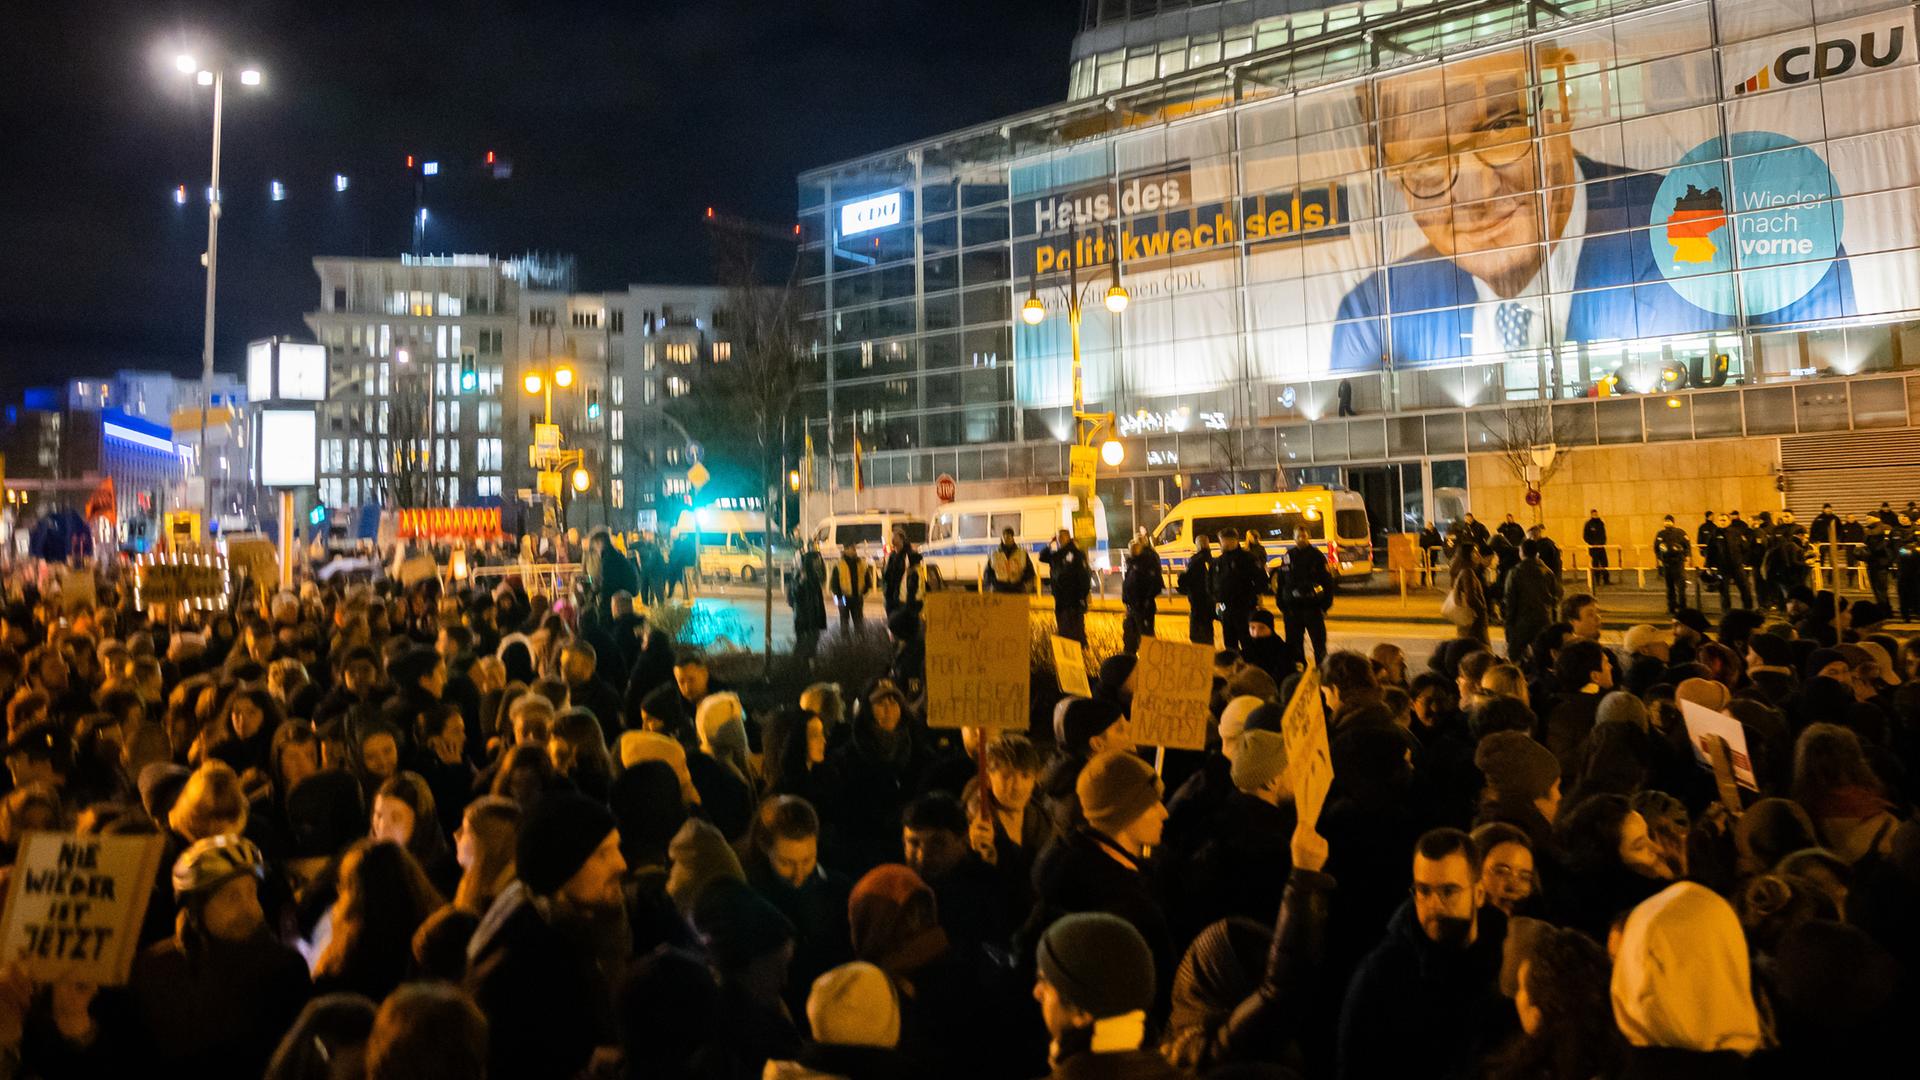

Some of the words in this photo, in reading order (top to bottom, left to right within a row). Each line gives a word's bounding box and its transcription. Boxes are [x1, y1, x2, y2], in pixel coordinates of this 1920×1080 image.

[1773, 25, 1904, 84] CDU
[1035, 193, 1110, 234] Haus
[1121, 178, 1180, 215] des
[1742, 190, 1827, 211] Wieder
[1741, 212, 1798, 233] nach
[1741, 238, 1814, 255] vorne
[1164, 270, 1206, 294] CDU.
[928, 606, 989, 633] HASS
[1147, 640, 1175, 668] OB
[1145, 667, 1175, 692] OB
[59, 842, 100, 869] NIE
[25, 868, 116, 900] WIEDER
[25, 926, 113, 960] JETZT
